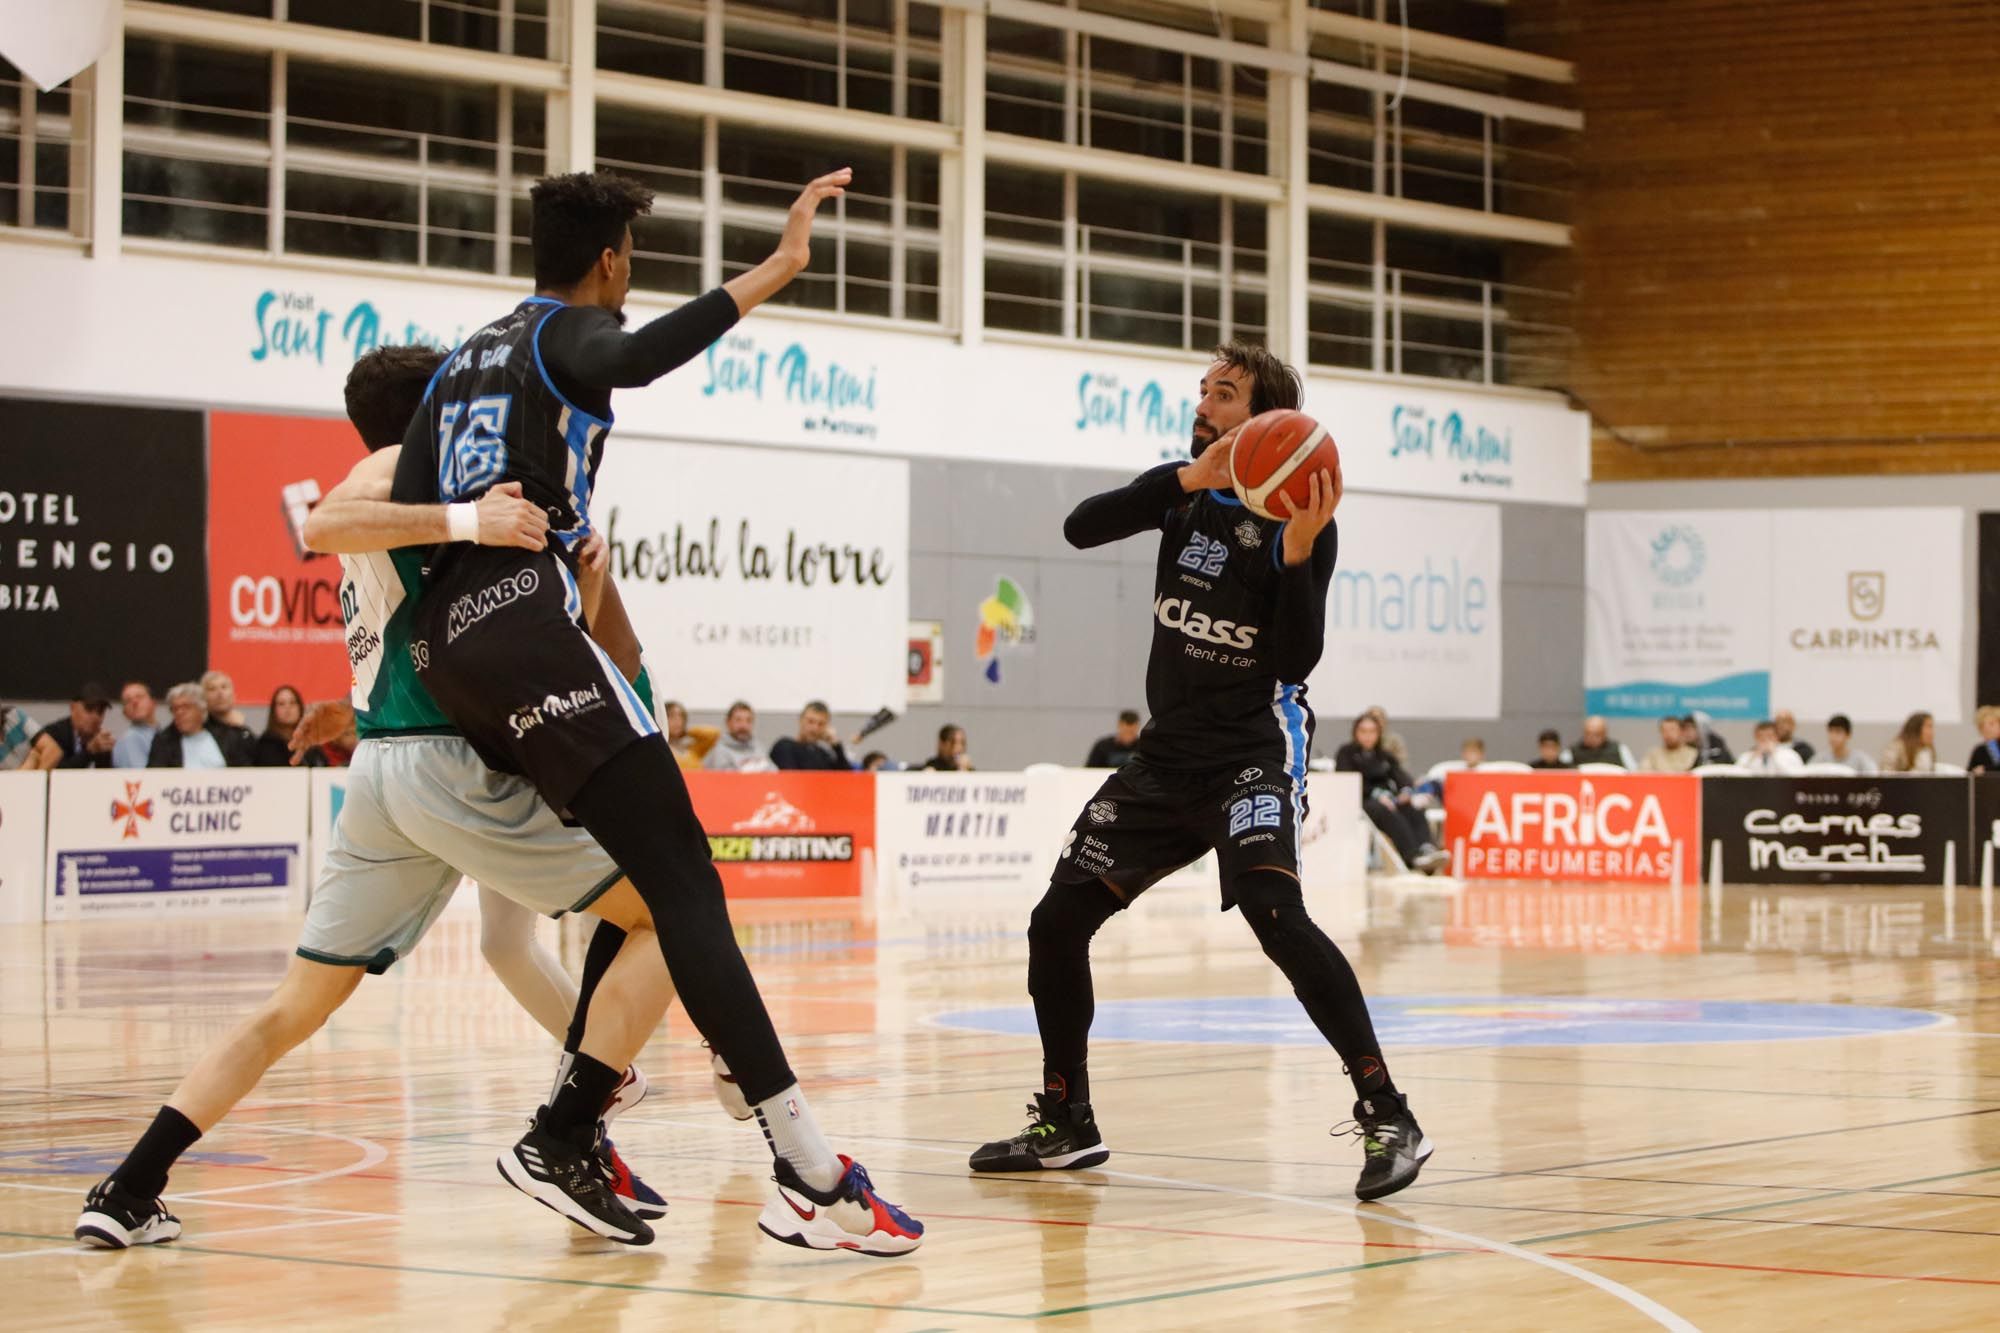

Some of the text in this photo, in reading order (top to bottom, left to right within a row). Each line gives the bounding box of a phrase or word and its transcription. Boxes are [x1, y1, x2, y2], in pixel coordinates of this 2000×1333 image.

[282, 292, 315, 310] Visit
[251, 290, 332, 365] Sant
[702, 338, 877, 412] Sant Antoni
[1075, 371, 1129, 431] Sant
[0, 538, 174, 573] ENCIO
[608, 506, 893, 587] hostal la torre
[1177, 530, 1229, 577] 22
[447, 568, 540, 644] MAMBO
[1332, 554, 1489, 635] marble
[693, 623, 812, 647] CAP NEGRET
[1789, 628, 1941, 651] CARPINTSA
[1184, 643, 1257, 668] Rent a car
[508, 682, 601, 739] Sant Antoni
[1250, 783, 1286, 796] MOTOR
[170, 810, 242, 834] CLINIC
[1229, 794, 1282, 838] 22
[1743, 808, 1922, 838] Carnes
[1080, 844, 1115, 868] Feeling
[1084, 834, 1109, 852] Ibiza
[1748, 832, 1926, 872] March
[1074, 854, 1107, 876] Hotels
